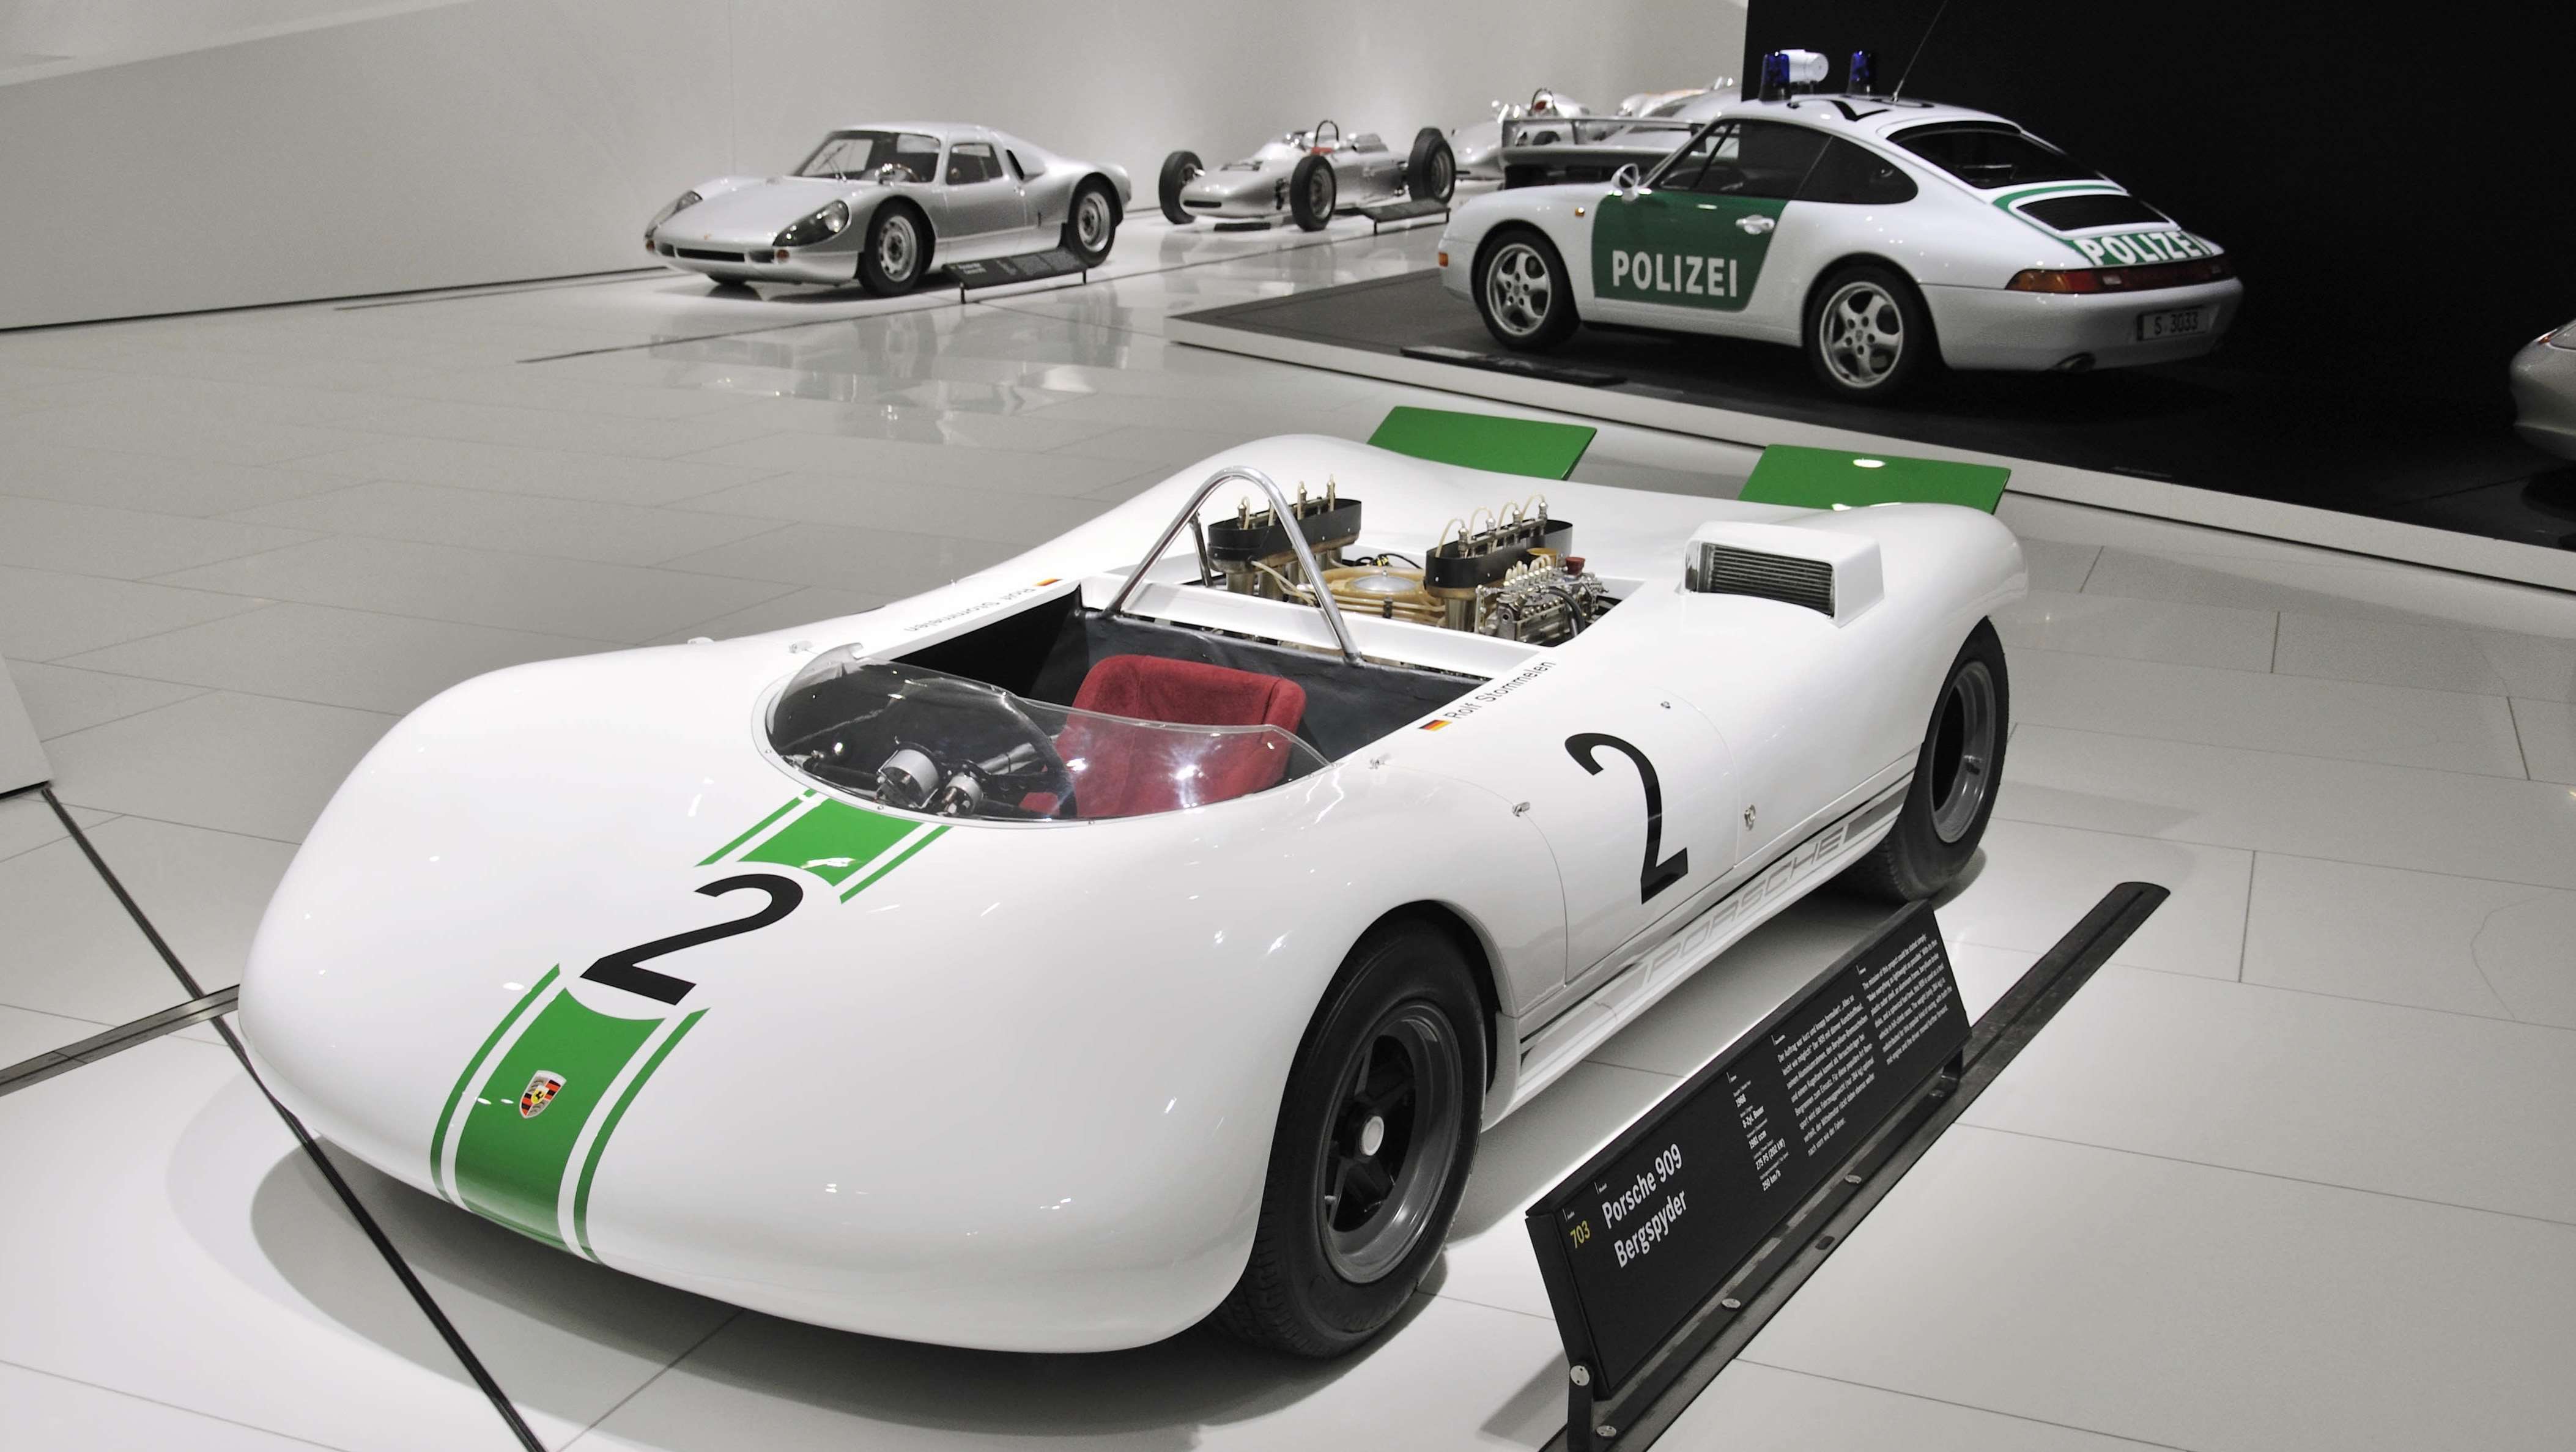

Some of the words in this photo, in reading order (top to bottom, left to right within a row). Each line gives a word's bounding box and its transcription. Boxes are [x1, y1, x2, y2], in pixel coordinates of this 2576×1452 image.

[1612, 250, 1737, 297] POLIZEI
[2073, 231, 2211, 265] POLIZEI
[2155, 316, 2162, 335] S
[2170, 311, 2199, 333] 3033
[1443, 703, 1482, 719] Rolf
[1475, 661, 1556, 702] Stommelen
[1564, 733, 1688, 905] 2
[1645, 826, 1846, 983] PORSCHE
[580, 873, 803, 1006] 2
[1602, 1172, 1657, 1229] Porsche
[1655, 1143, 1682, 1183] 909
[1755, 1157, 1764, 1170] 275
[1762, 1152, 1769, 1164] PS
[1570, 1220, 1590, 1248] 703
[1614, 1190, 1687, 1268] Bergspyder
